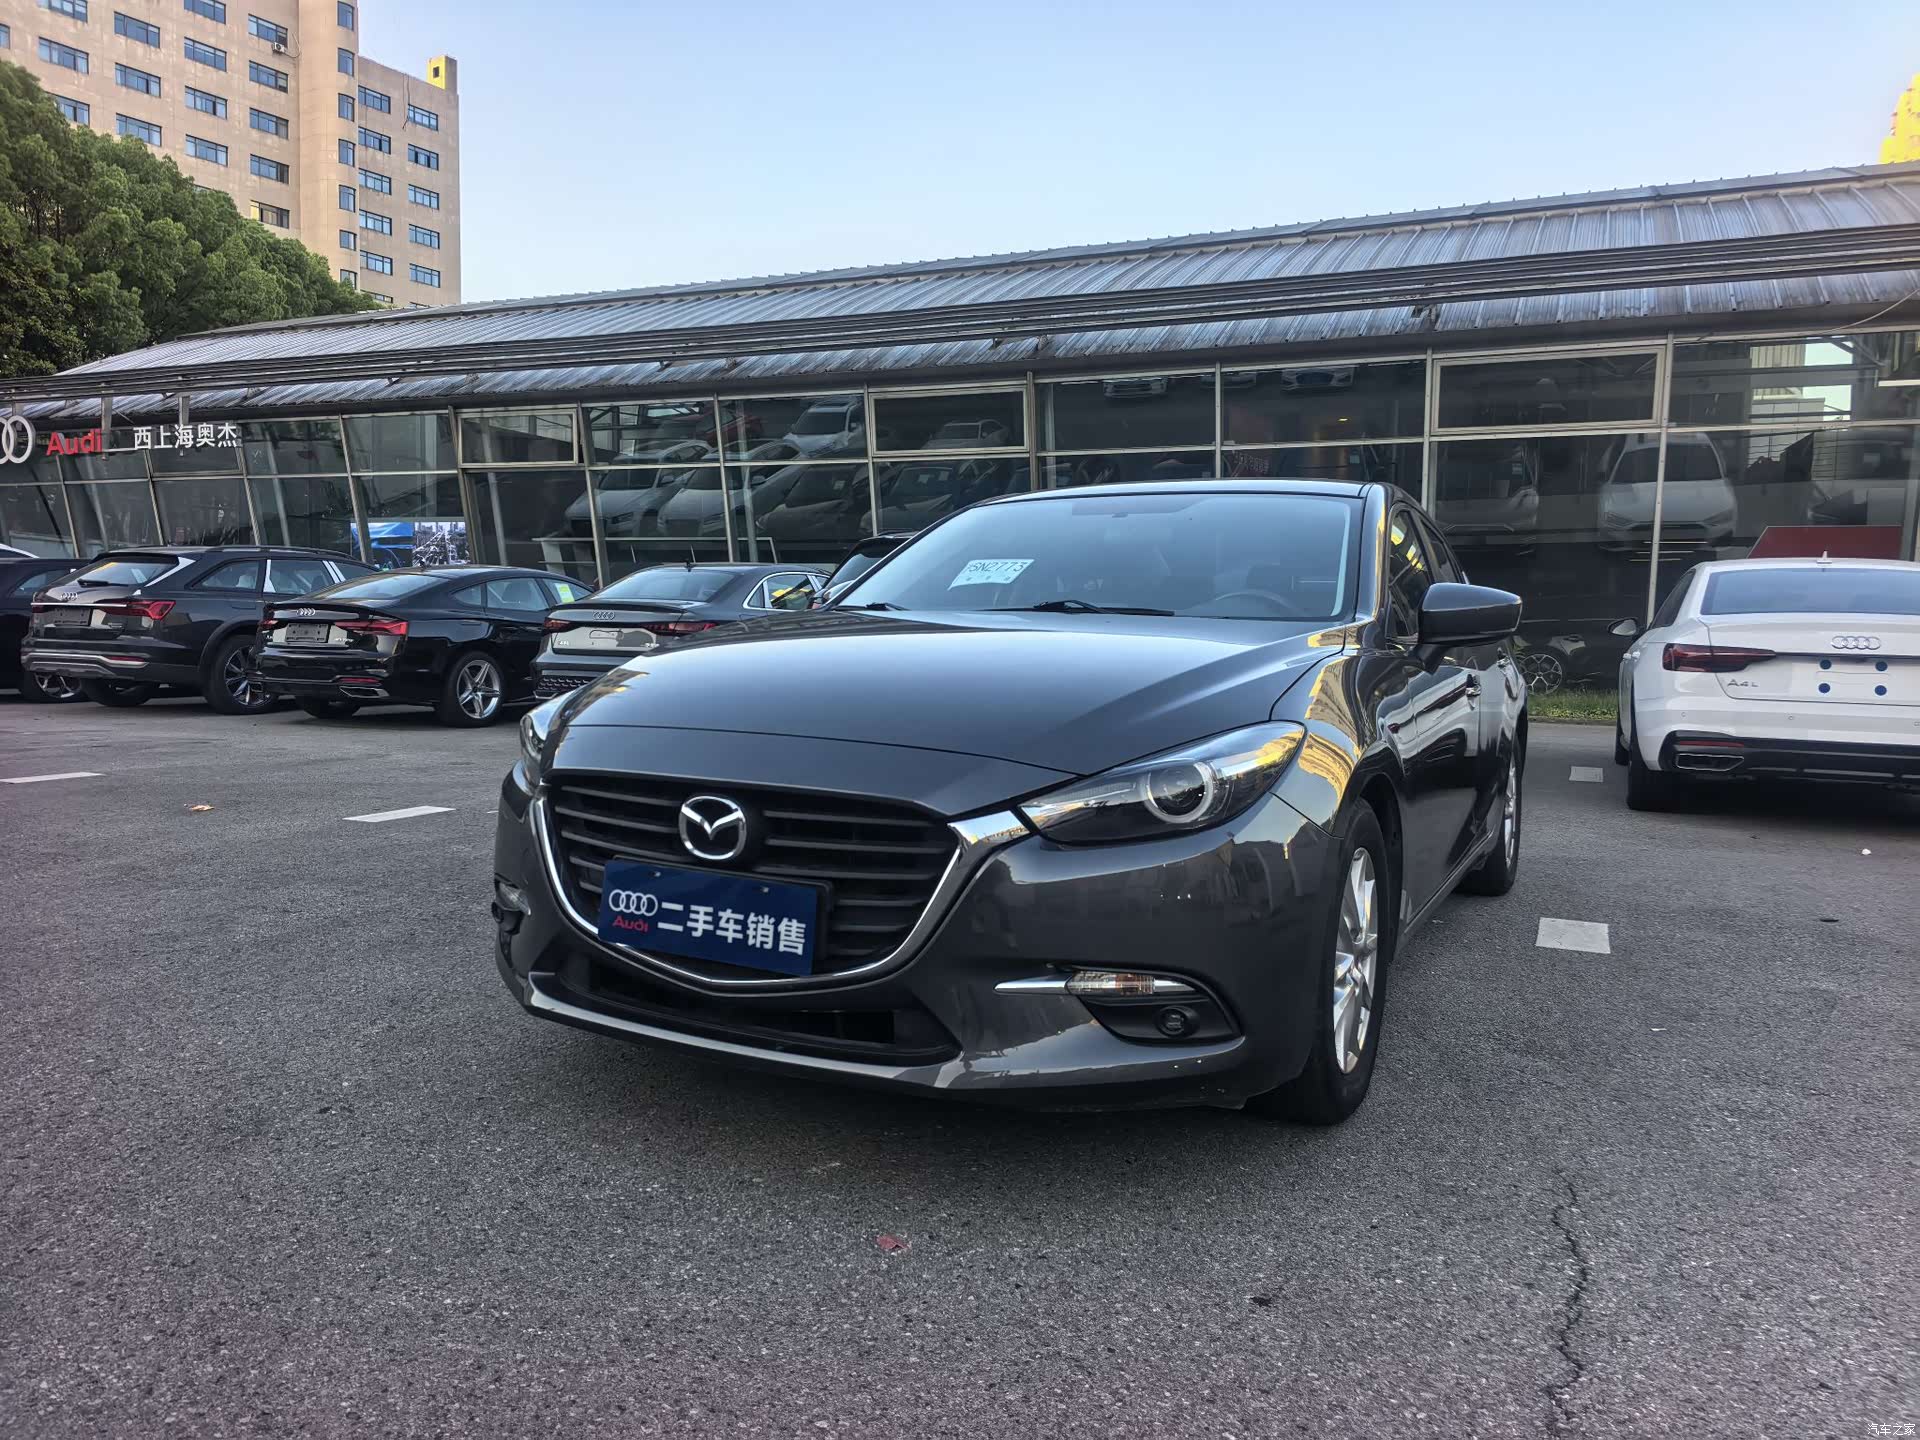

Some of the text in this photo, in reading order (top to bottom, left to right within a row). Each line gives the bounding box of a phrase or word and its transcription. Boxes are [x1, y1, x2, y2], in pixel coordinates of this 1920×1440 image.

[46, 429, 102, 456] Audi
[132, 423, 237, 449] 西上海奥杰
[612, 915, 649, 933] Audi
[657, 901, 806, 955] 二手车销售
